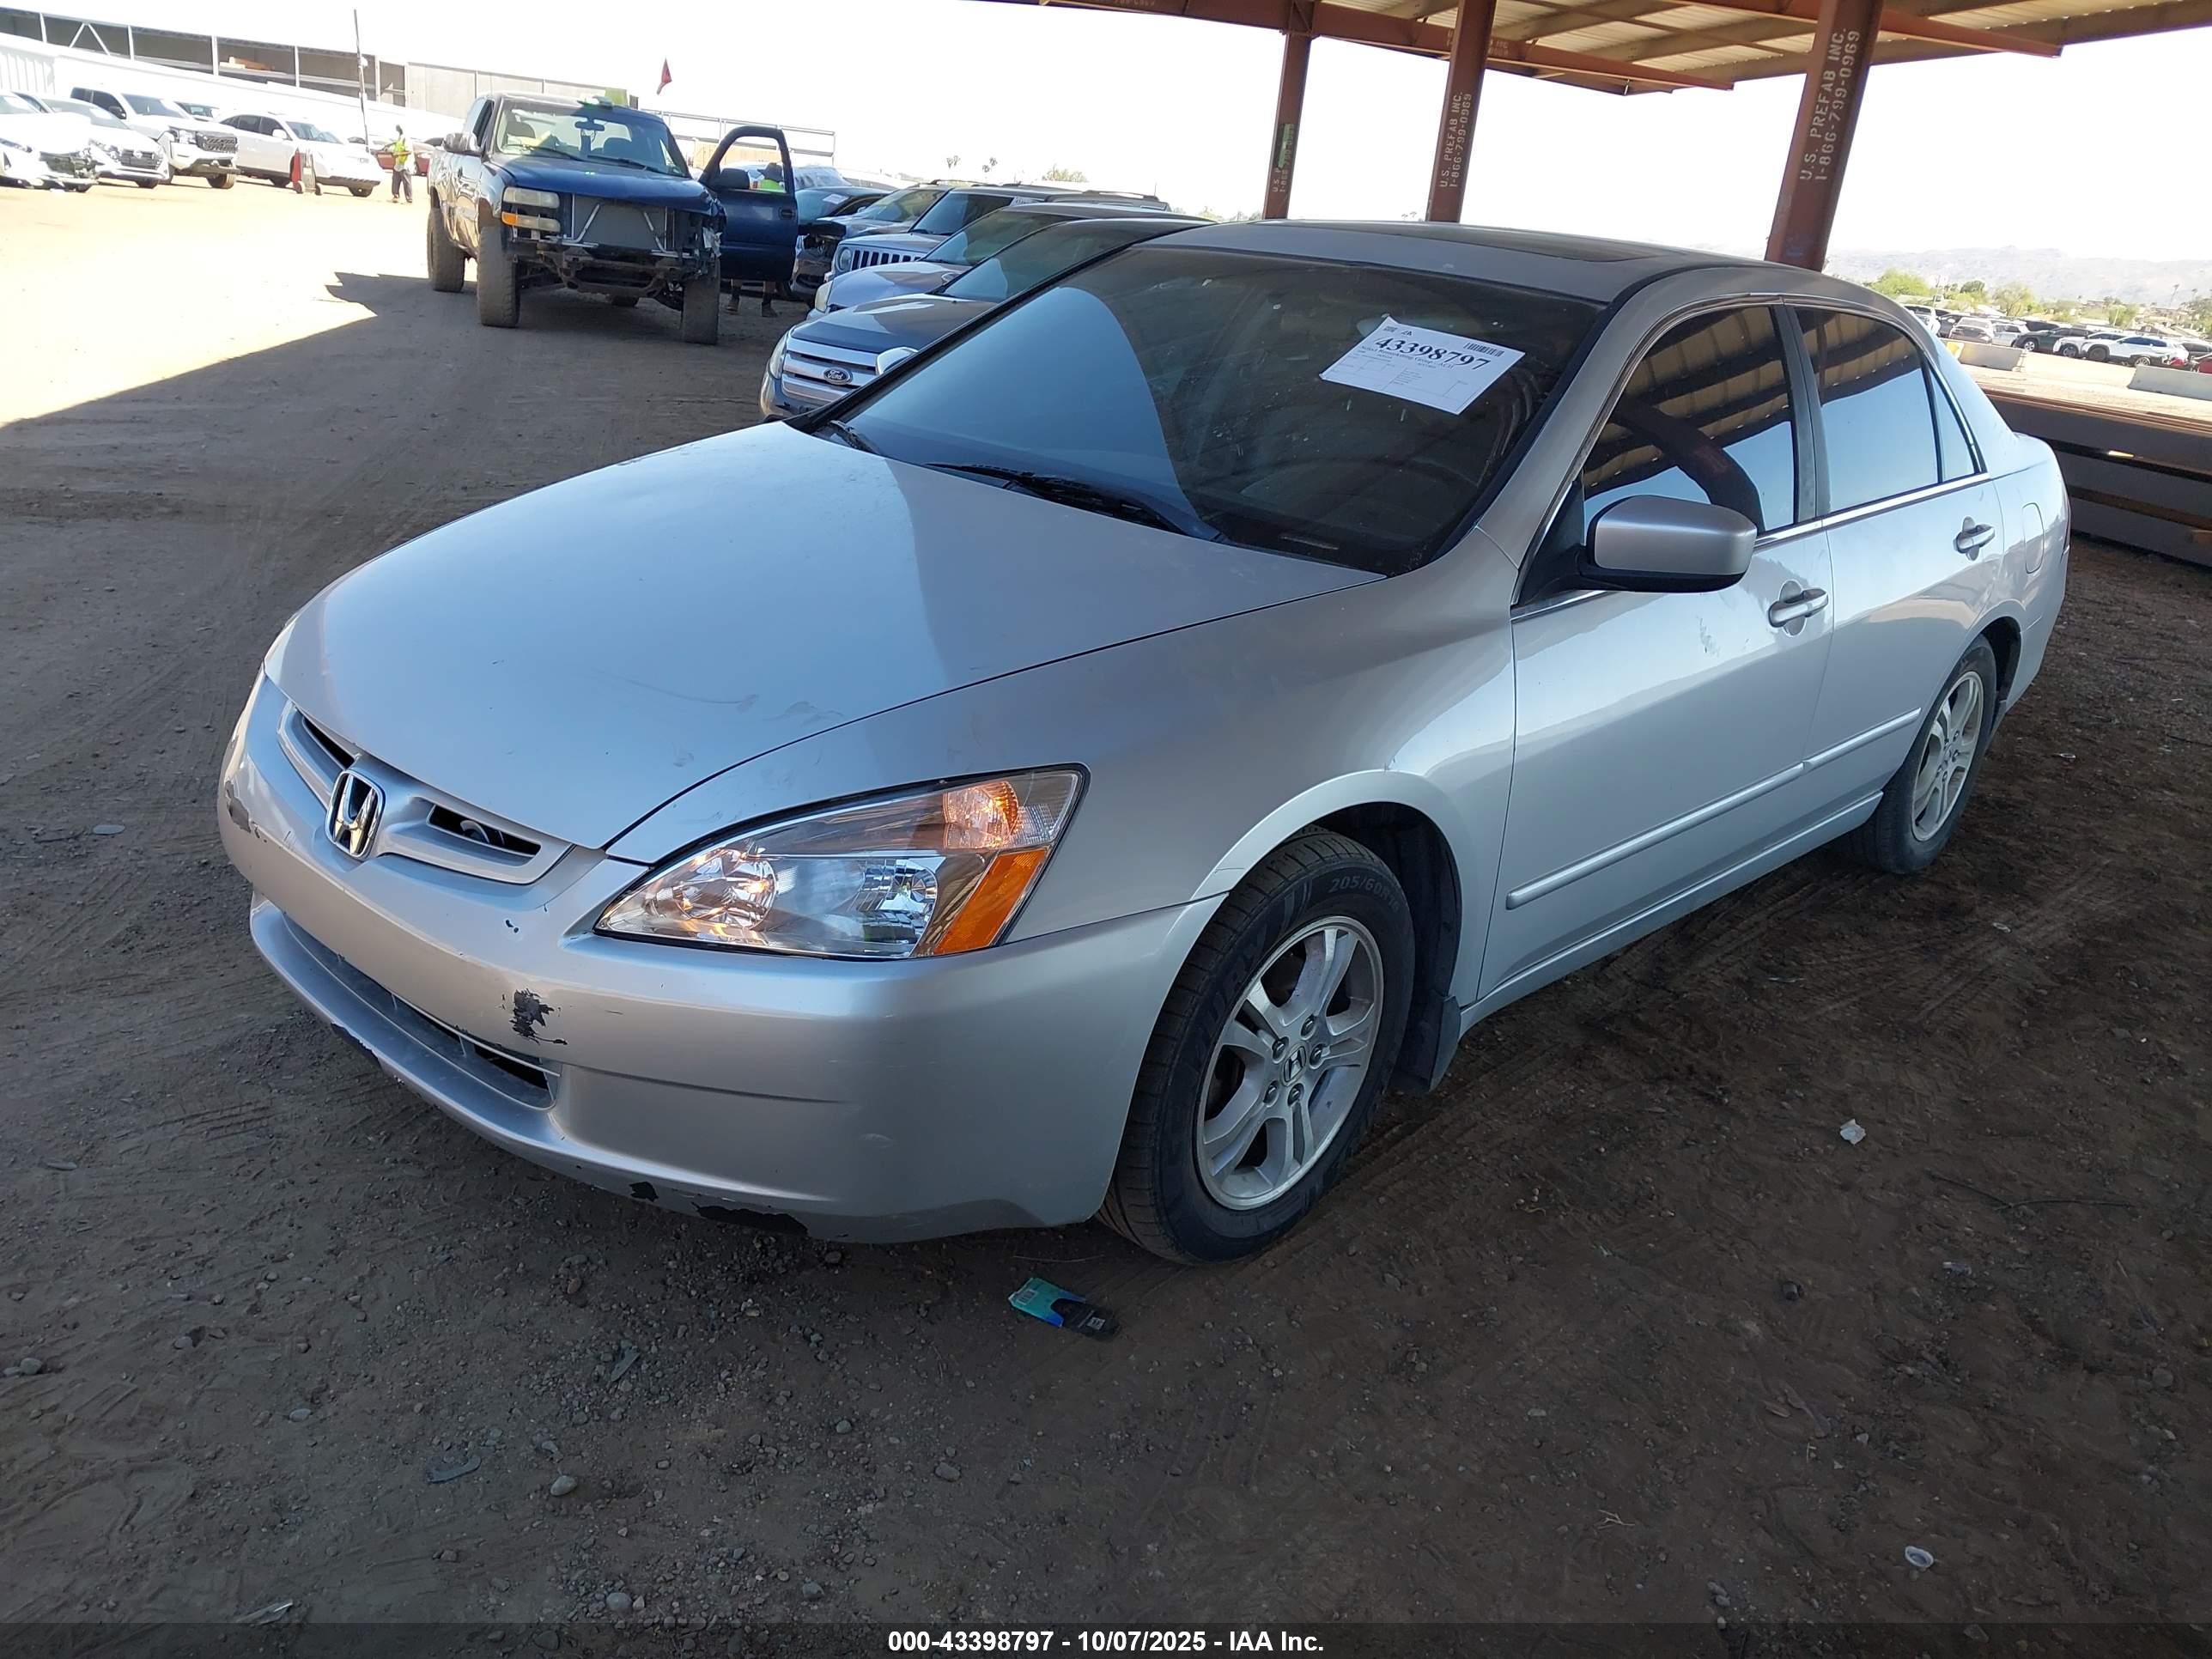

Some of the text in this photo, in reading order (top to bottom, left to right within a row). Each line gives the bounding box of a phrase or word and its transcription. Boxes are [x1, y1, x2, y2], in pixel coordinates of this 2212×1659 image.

[1444, 118, 1458, 161] PREFAB
[1800, 28, 1846, 180] U.S. PREFAB INC.
[1815, 29, 1860, 180] 1-866-799-0969
[1375, 337, 1491, 370] 43398797
